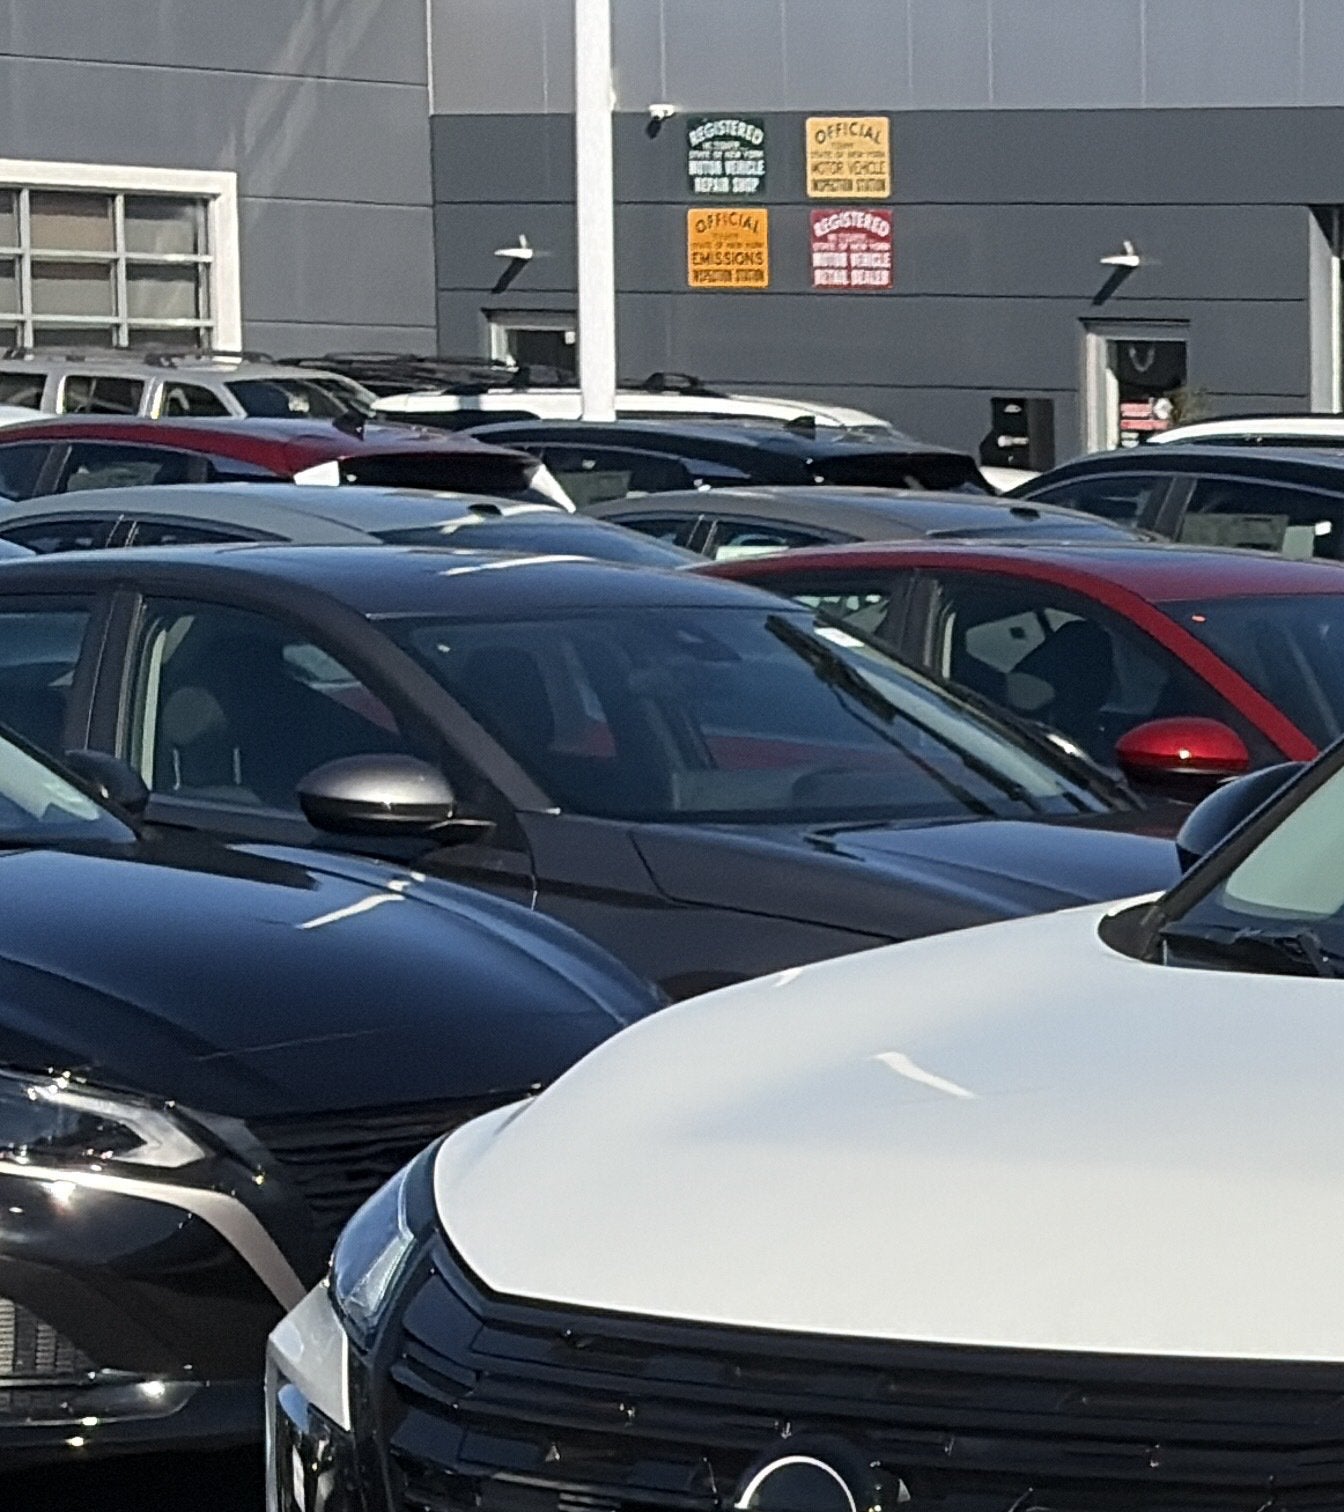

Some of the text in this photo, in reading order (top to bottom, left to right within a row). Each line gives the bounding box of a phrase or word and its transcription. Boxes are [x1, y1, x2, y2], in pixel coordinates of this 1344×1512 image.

[689, 119, 764, 147] REGISTERED
[815, 122, 881, 144] OFFICIAL
[811, 161, 886, 175] MOTOR VEHICLE
[695, 212, 759, 233] OFFICIAL
[813, 211, 890, 237] REGISTERED
[692, 251, 764, 266] EMISSIONS
